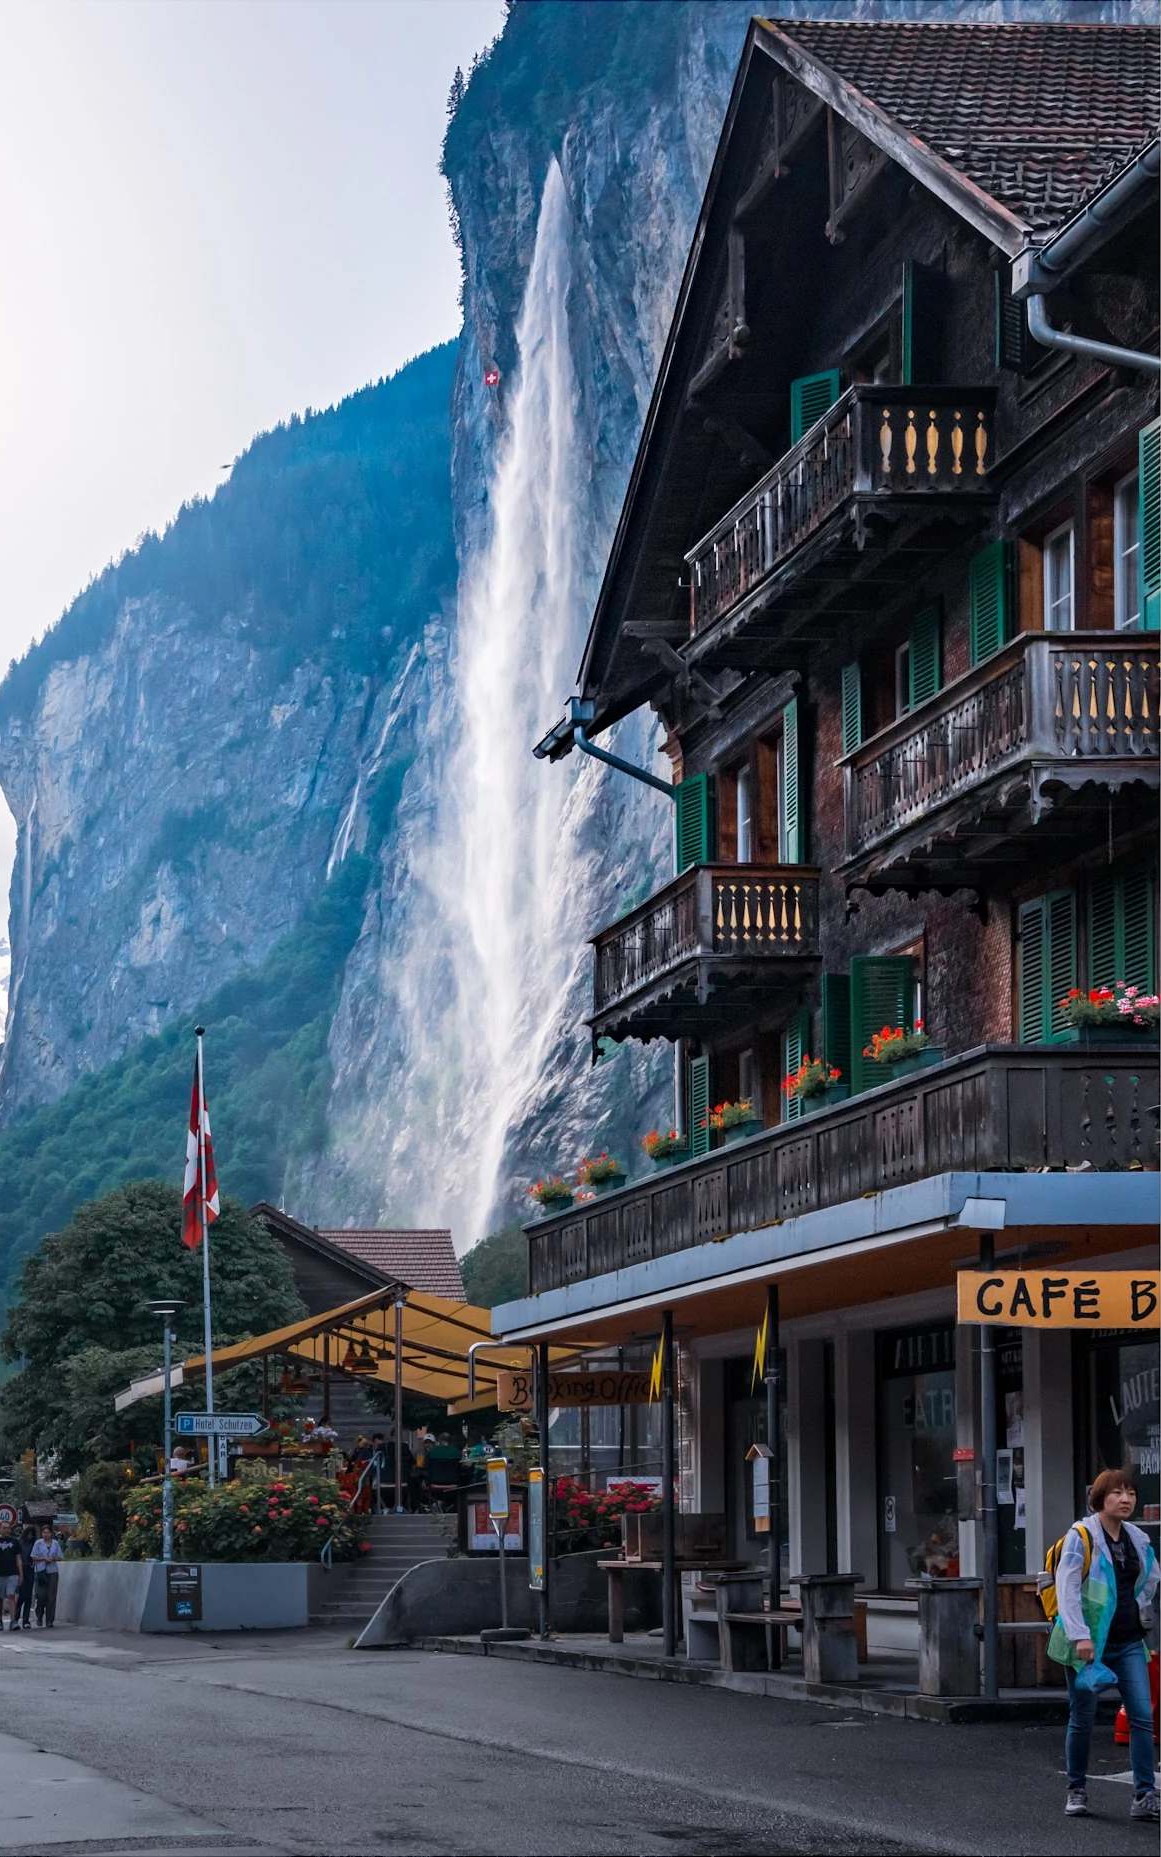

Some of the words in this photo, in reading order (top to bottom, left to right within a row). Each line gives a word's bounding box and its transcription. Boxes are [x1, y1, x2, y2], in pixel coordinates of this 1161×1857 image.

[976, 1277, 1101, 1319] CAFÉ
[1130, 1280, 1157, 1321] B
[508, 1376, 595, 1406] Boking
[195, 1418, 215, 1430] Hotel
[0, 1511, 10, 1520] 40
